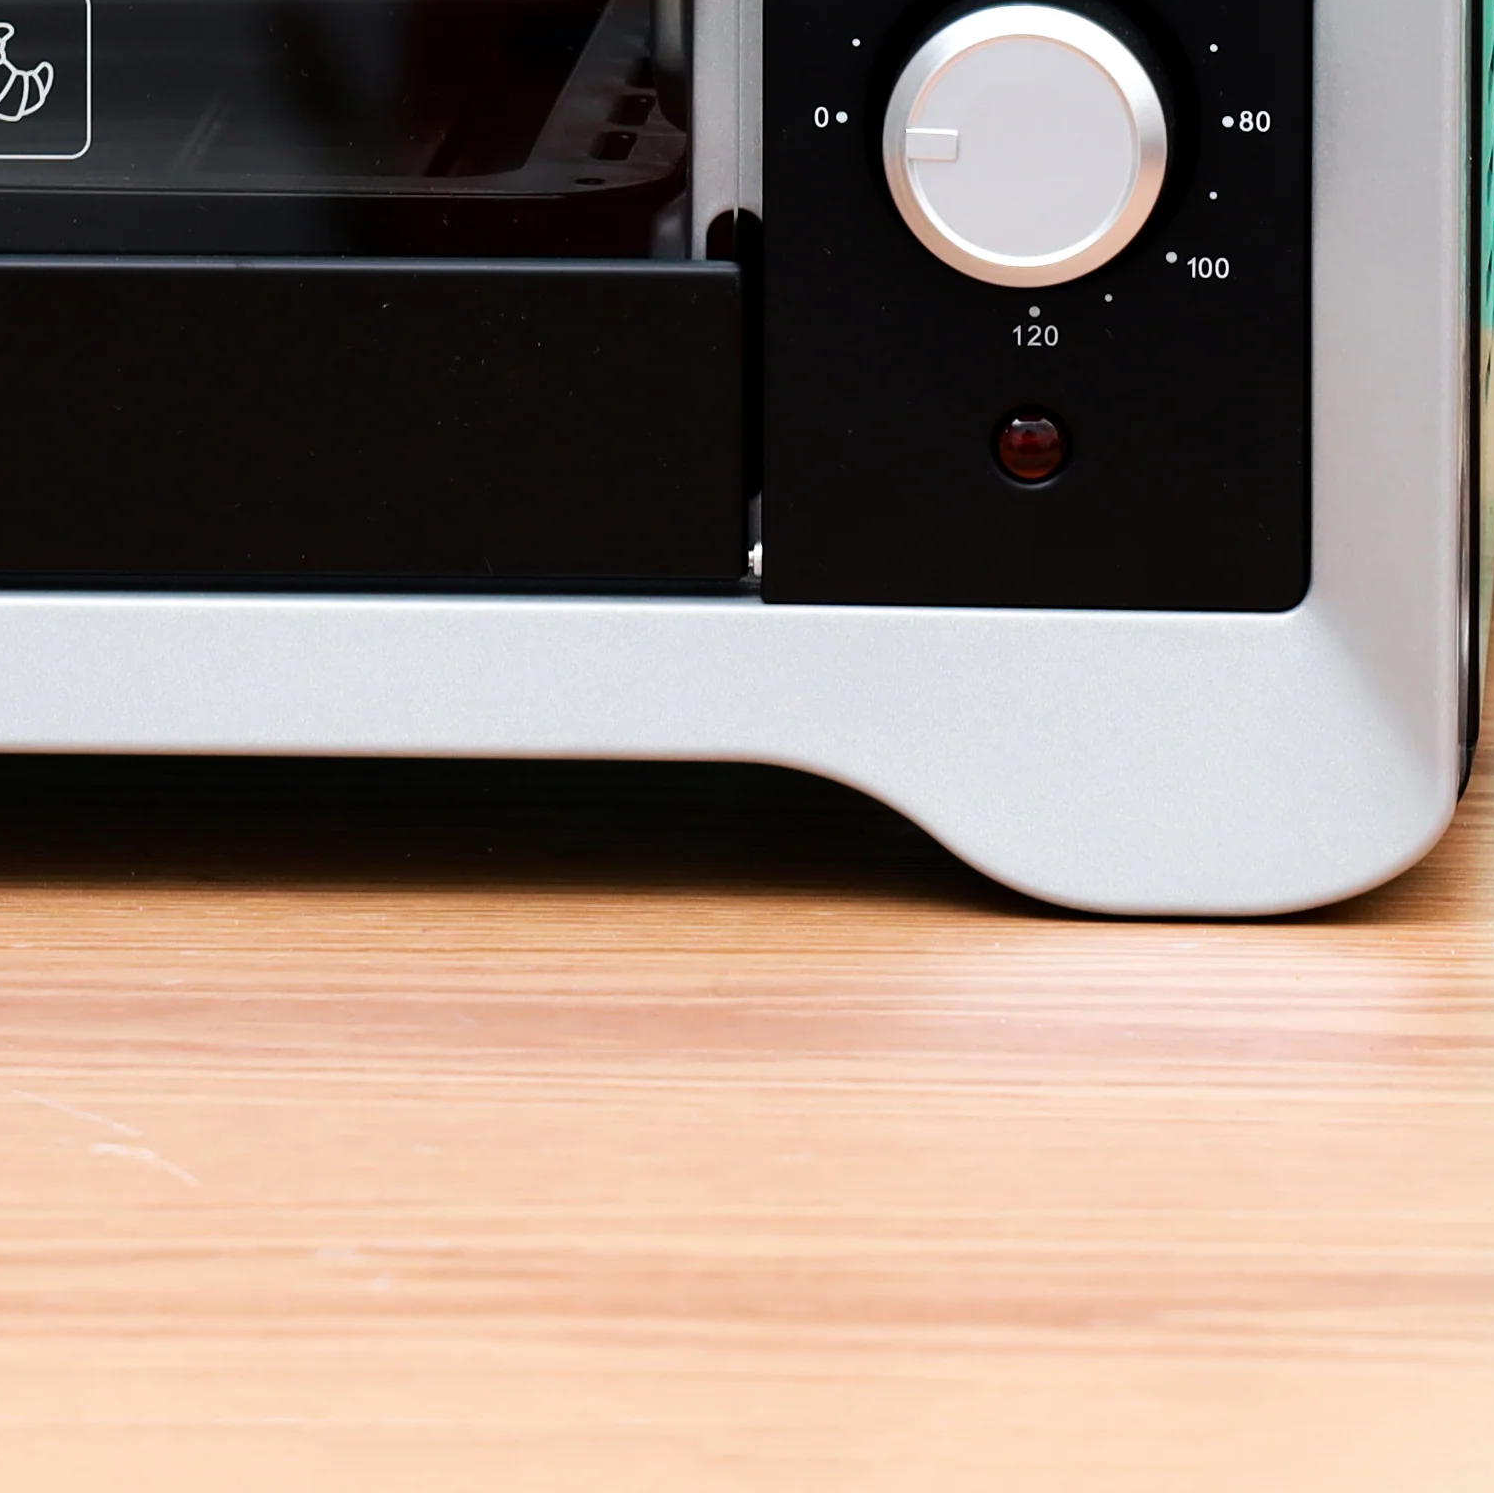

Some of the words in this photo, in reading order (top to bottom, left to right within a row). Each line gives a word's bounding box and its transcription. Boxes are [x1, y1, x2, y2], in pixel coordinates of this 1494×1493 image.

[814, 106, 829, 128] 0
[1239, 110, 1271, 133] 80
[1187, 256, 1230, 279] 100
[1012, 324, 1059, 347] 120
